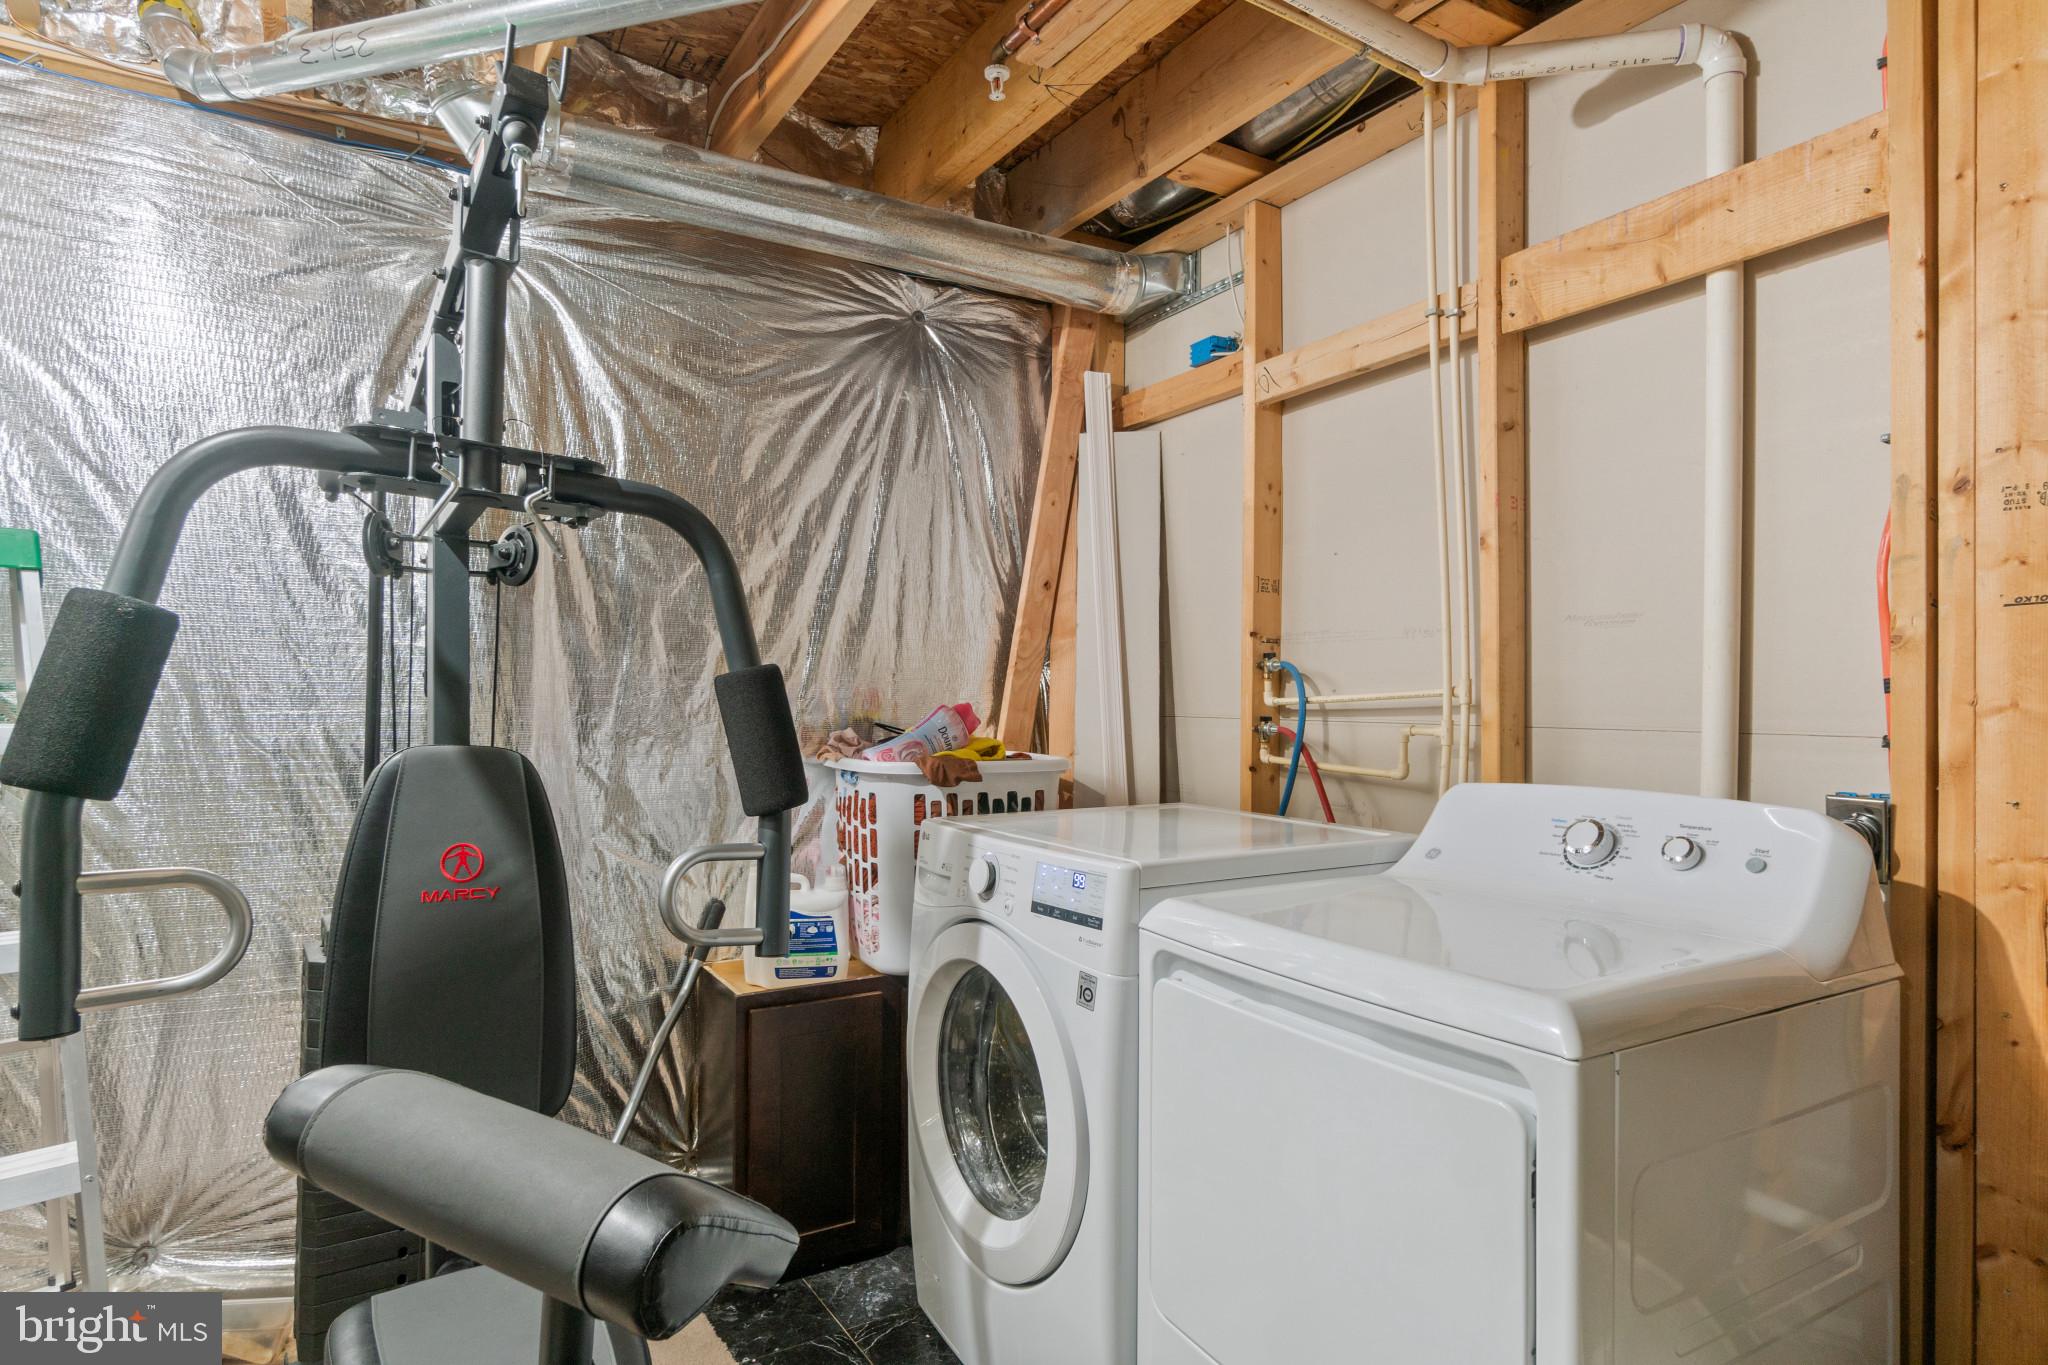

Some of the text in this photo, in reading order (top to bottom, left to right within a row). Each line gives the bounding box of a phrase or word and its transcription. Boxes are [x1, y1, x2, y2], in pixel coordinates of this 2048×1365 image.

[2003, 498, 2027, 506] STUD
[1073, 873, 1086, 889] 99
[421, 886, 502, 903] MARCY
[1079, 985, 1094, 1003] 10
